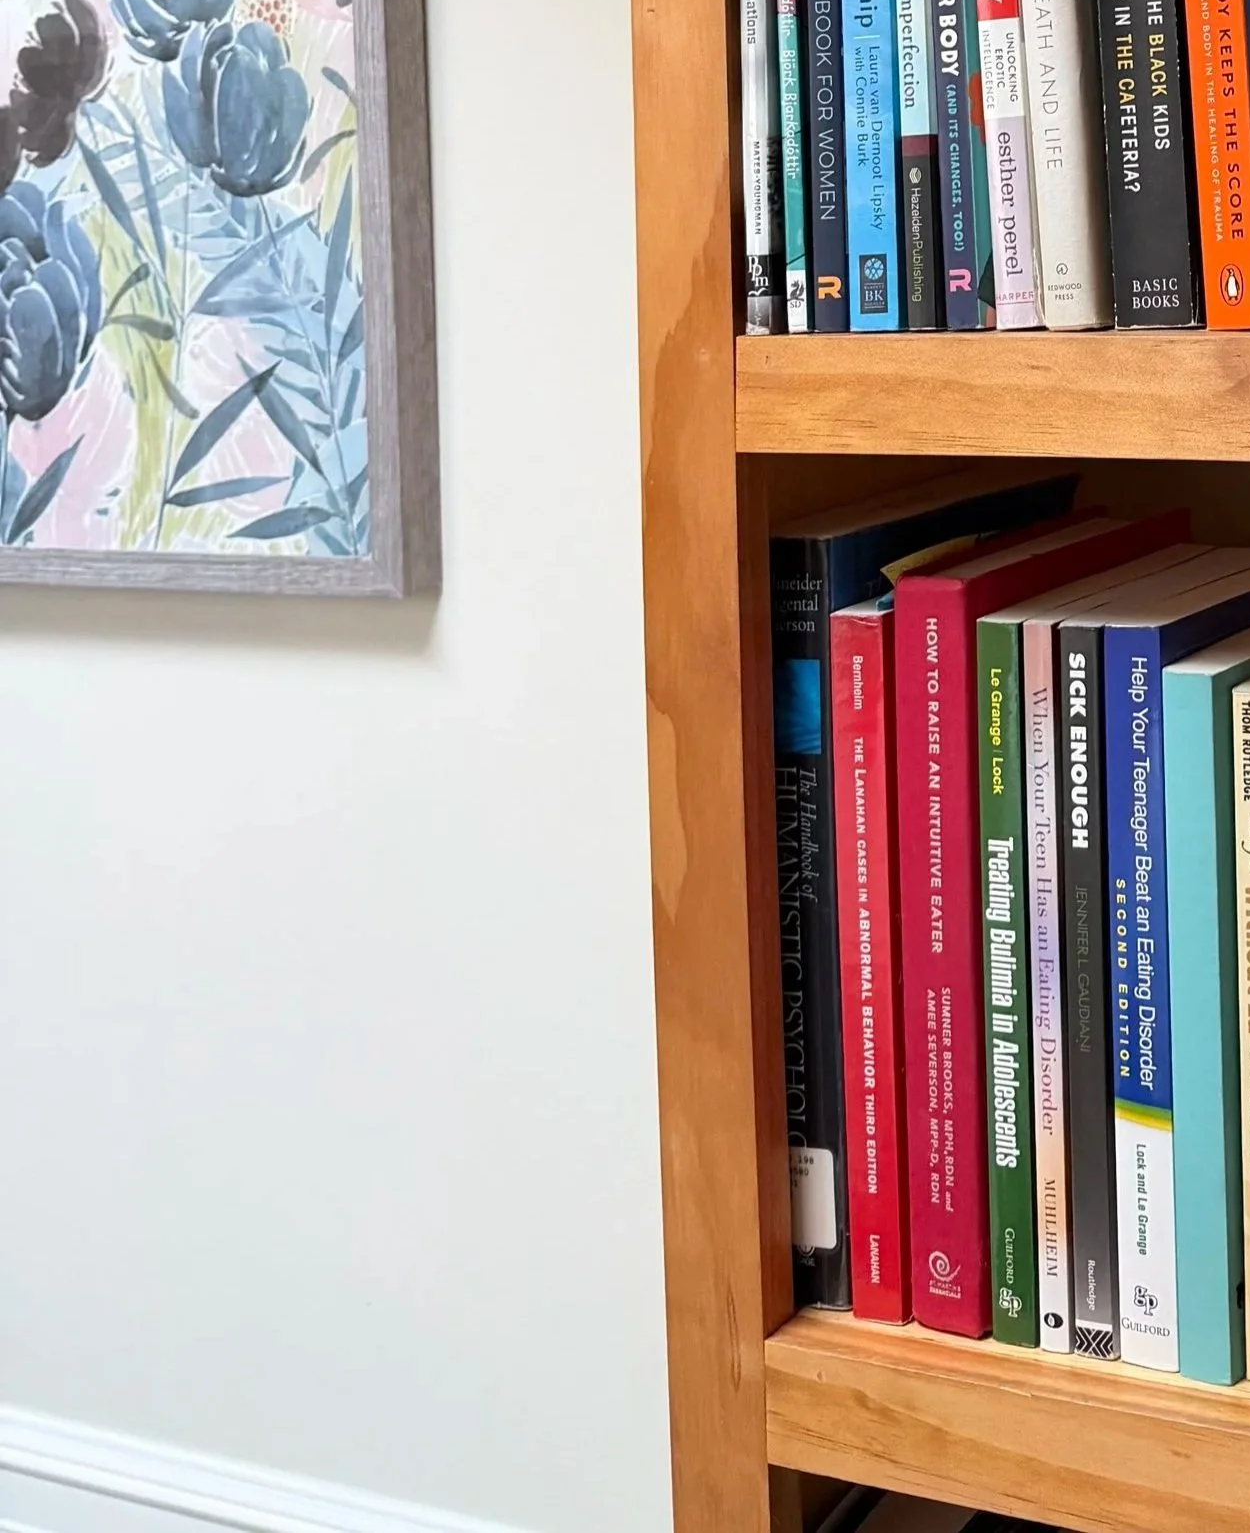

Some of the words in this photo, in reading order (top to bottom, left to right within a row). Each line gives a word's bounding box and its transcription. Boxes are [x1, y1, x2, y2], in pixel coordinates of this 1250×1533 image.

[939, 14, 960, 76] BODY
[1149, 34, 1167, 96] BLACK
[1219, 28, 1235, 97] KEEPS
[817, 75, 834, 121] FOR
[1152, 105, 1171, 150] KIDS
[1223, 108, 1238, 151] THE
[818, 129, 836, 220] WOMEN
[997, 132, 1017, 207] esther
[1227, 163, 1244, 240] SCORE
[911, 187, 923, 302] HazeldenPublishing
[998, 215, 1022, 277] perel
[1132, 278, 1178, 292] BASIC
[1132, 295, 1180, 309] BOOKS
[926, 617, 939, 663] HOW
[927, 669, 939, 694] TO
[1069, 652, 1086, 717] SICK
[928, 701, 940, 755] RAISE
[929, 762, 941, 788] AN
[1070, 726, 1089, 848] ENOUGH
[929, 795, 942, 888] INTUITIVE
[986, 837, 1015, 922] Treating
[931, 895, 943, 953] EATER
[990, 928, 1018, 1008] Bulimia
[992, 1013, 1018, 1034] in
[993, 1038, 1021, 1168] Adolescents
[1044, 1178, 1058, 1277] MUHLHEIM
[1121, 1317, 1170, 1337] GUILFORD
